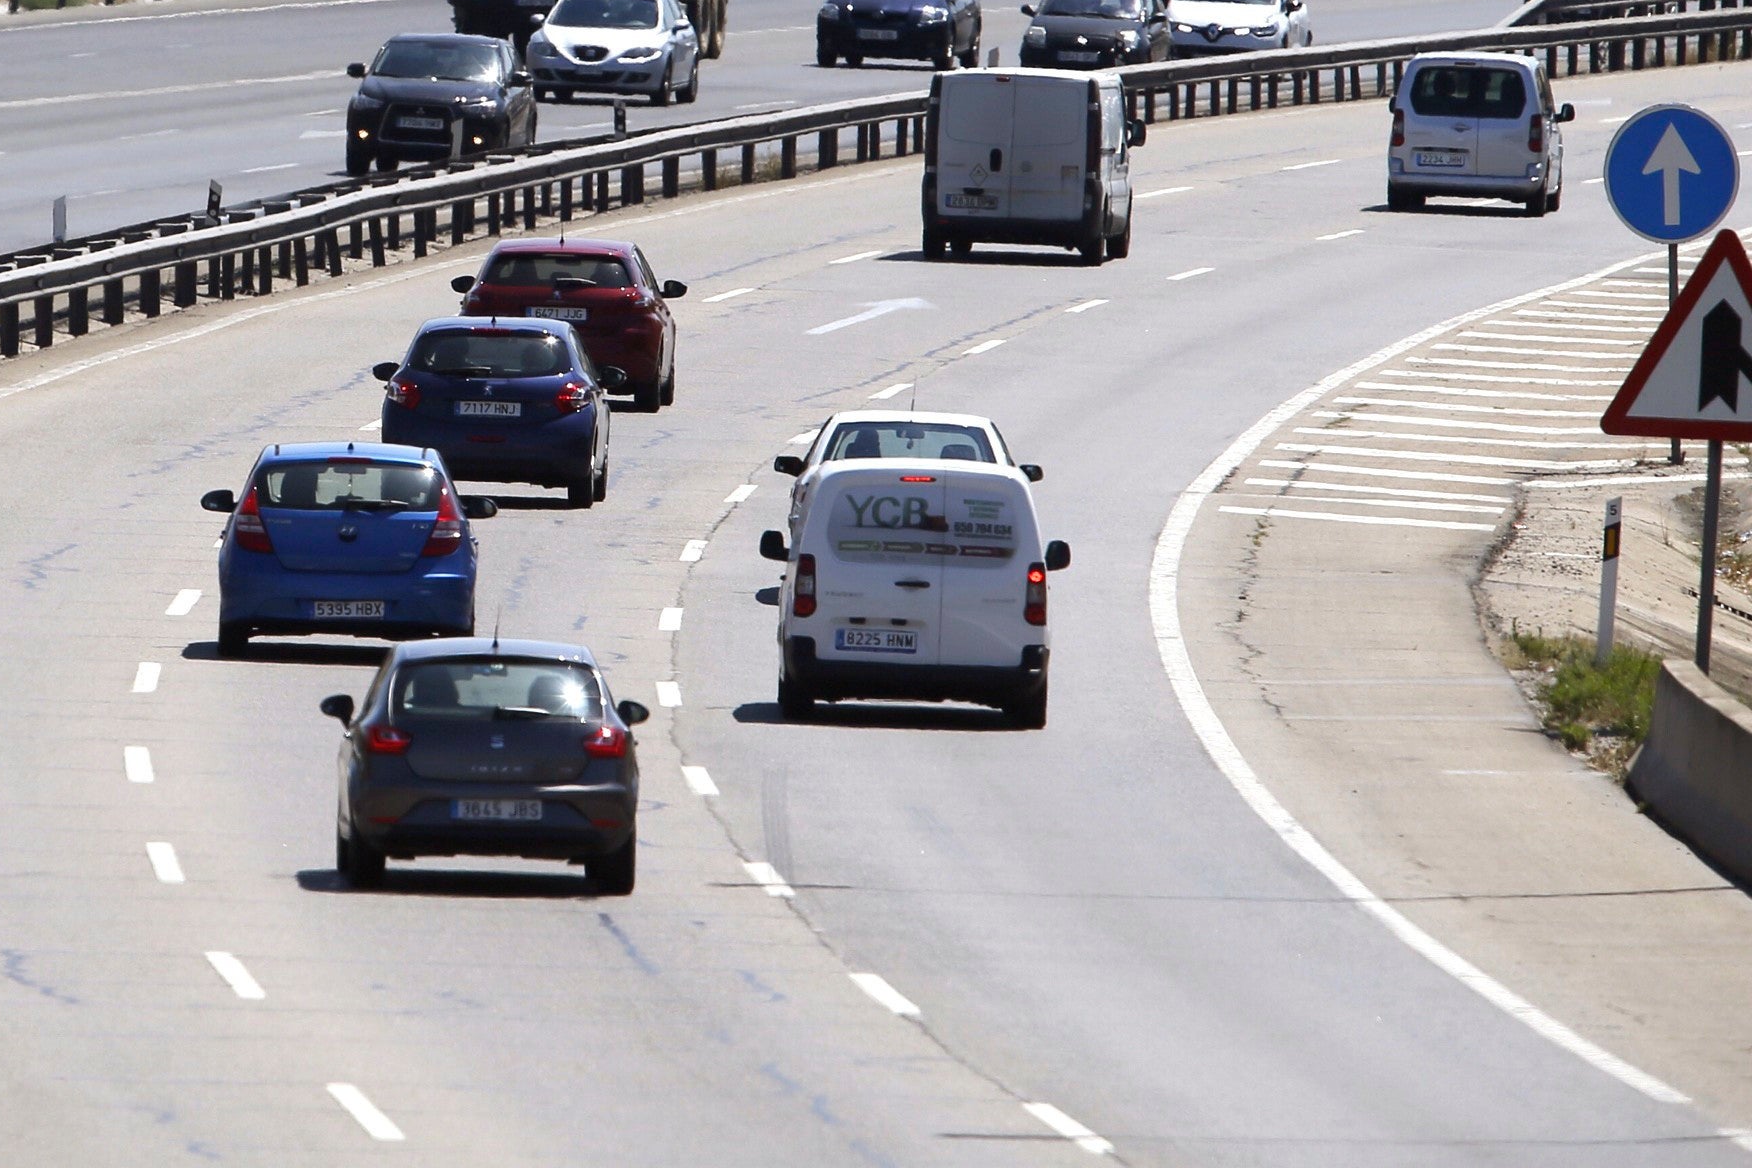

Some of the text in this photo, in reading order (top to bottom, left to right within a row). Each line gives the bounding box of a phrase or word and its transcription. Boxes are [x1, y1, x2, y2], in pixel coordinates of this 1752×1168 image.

[535, 308, 559, 318] 6471
[463, 402, 516, 414] 7117 HNJ
[845, 495, 929, 529] YCB
[1610, 504, 1618, 516] 5
[316, 602, 381, 616] 5395 HBX
[846, 632, 914, 648] 8225 HNM
